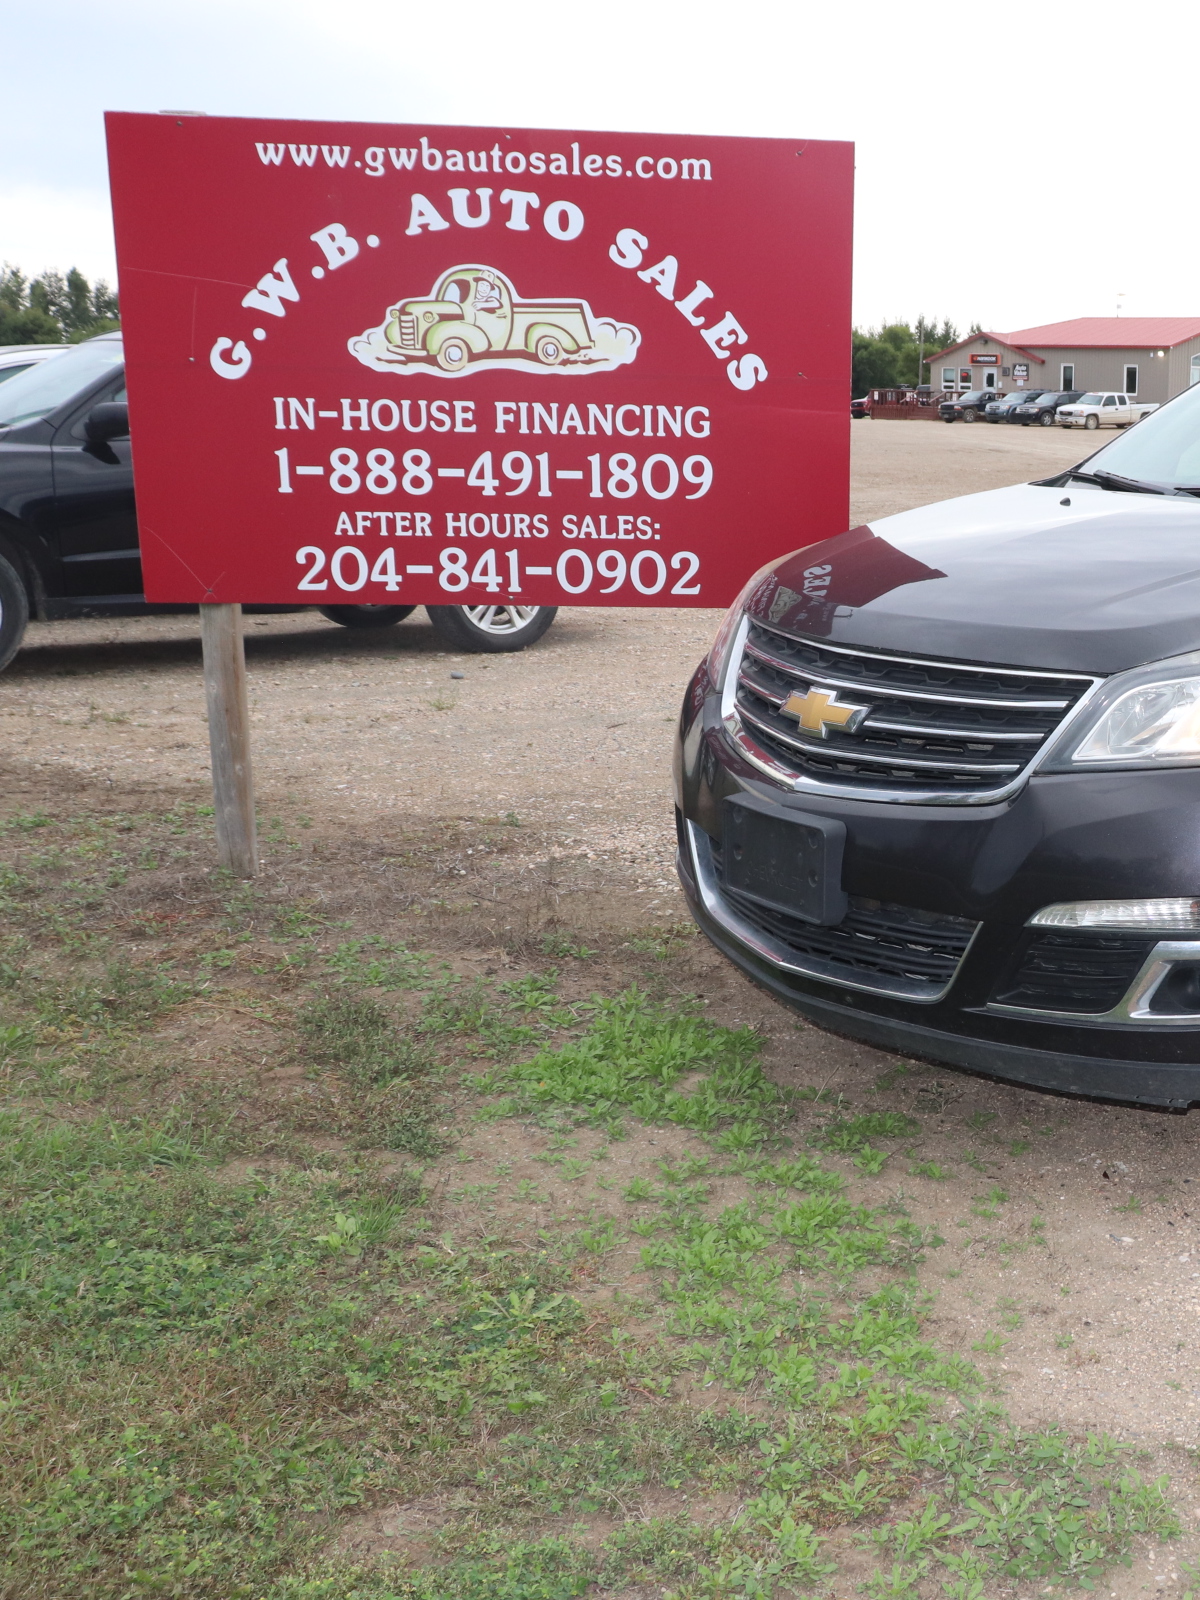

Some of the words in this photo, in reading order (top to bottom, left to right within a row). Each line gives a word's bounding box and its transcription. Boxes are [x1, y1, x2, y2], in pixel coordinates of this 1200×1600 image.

[255, 137, 713, 181] www.gwbautosales.com
[209, 222, 380, 380] G.W.B.
[405, 187, 585, 242] AUTO
[609, 227, 769, 391] SALES
[273, 396, 477, 434] IN-HOUSE
[494, 401, 711, 439] FINANCING
[275, 447, 714, 501] 1-888-491-1809
[335, 511, 433, 537] AFTER
[446, 512, 550, 539] HOURS
[561, 514, 661, 540] SALES:
[295, 545, 701, 595] 204-841-0902
